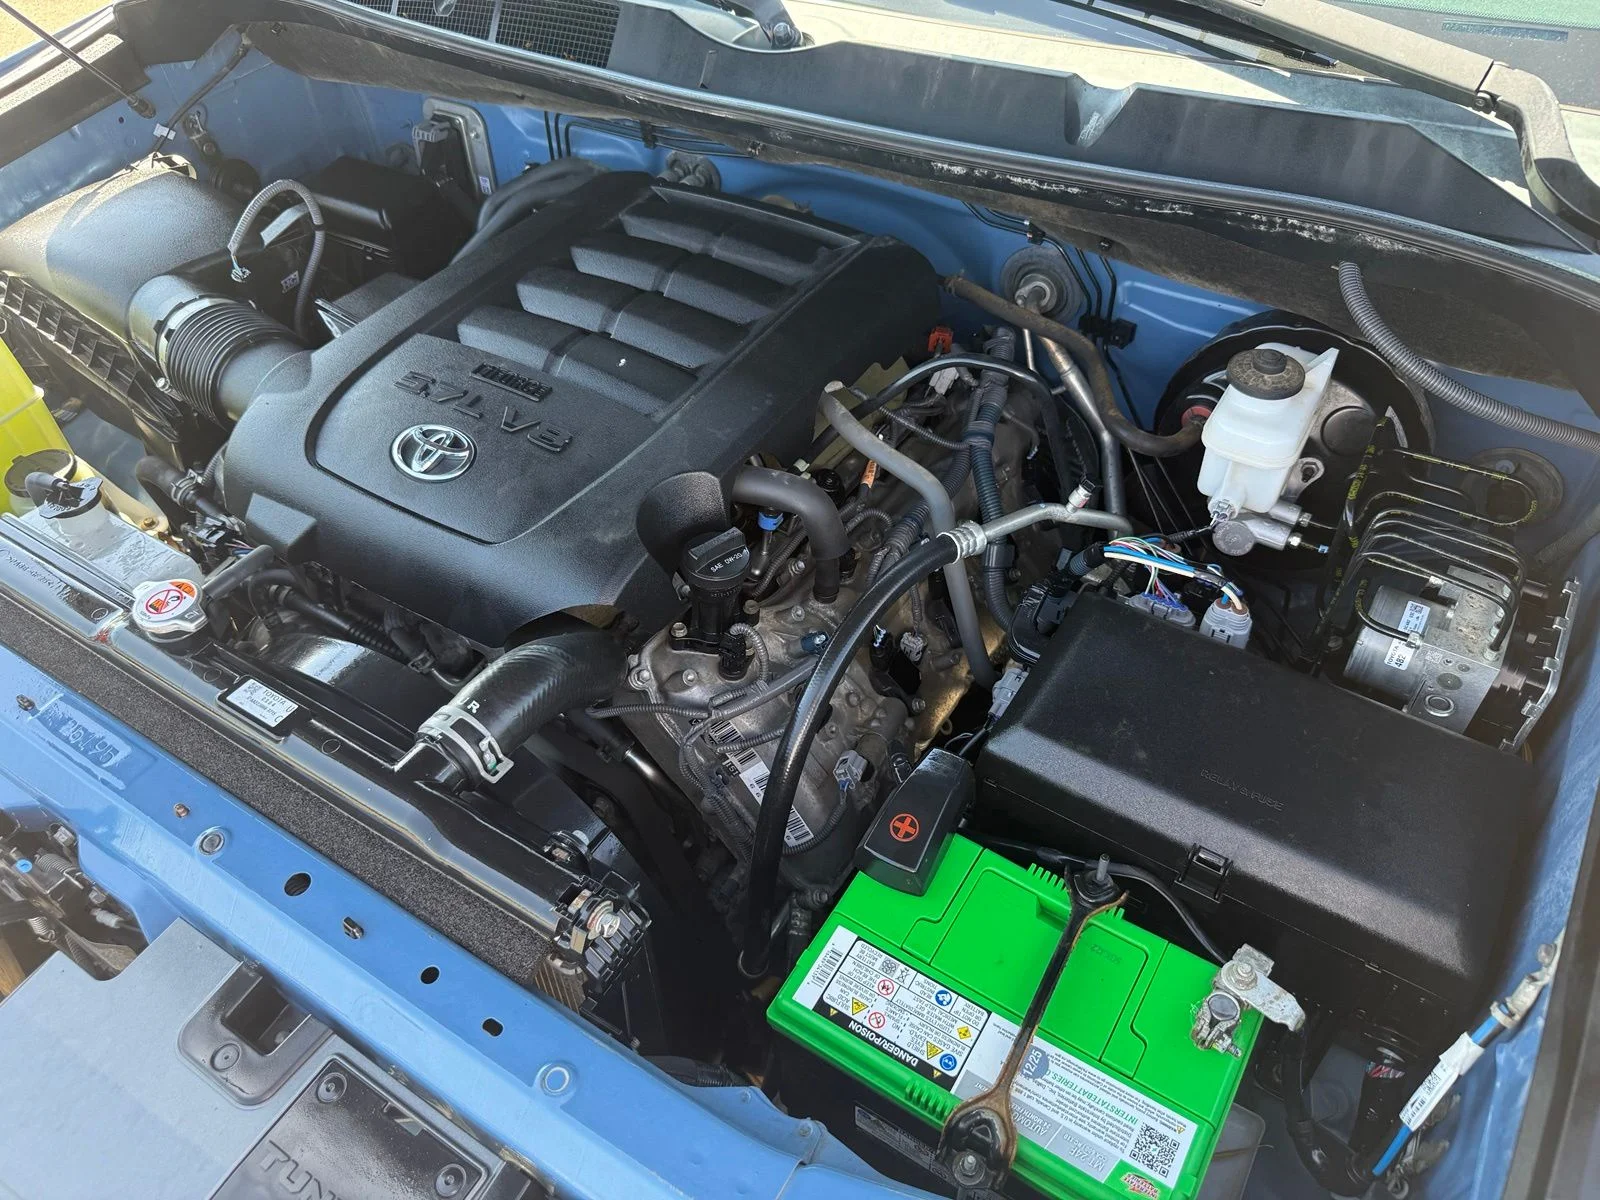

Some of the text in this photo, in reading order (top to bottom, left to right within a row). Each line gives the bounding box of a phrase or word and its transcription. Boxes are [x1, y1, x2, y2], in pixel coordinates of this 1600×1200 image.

[394, 371, 573, 452] 5.7L V8
[711, 563, 724, 573] SAE
[1395, 654, 1407, 668] 482
[263, 689, 286, 706] TOYOTA
[467, 700, 480, 714] R
[856, 953, 875, 966] BATTERY
[863, 950, 878, 961] MUST
[852, 967, 868, 978] REACH
[853, 973, 863, 981] OUT
[834, 978, 872, 1003] CAUSE BLINDNESS
[852, 982, 869, 996] SEVERE
[862, 979, 874, 988] KEEP
[837, 993, 849, 1003] ACID
[839, 987, 850, 996] CAN
[918, 989, 932, 999] READ
[825, 993, 850, 1010] SULFURIC
[915, 1003, 925, 1011] GET
[925, 1002, 937, 1012] HELP
[895, 998, 952, 1033] FLUSH EYES IMMEDIATELY
[937, 1009, 958, 1023] MEDICAL
[953, 1008, 961, 1016] TIP
[961, 1006, 975, 1017] OPEN
[961, 1013, 971, 1022] NOT
[891, 1022, 900, 1030] NO
[942, 1018, 955, 1028] WITH
[847, 1020, 919, 1066] DANGER/POISON
[908, 1021, 963, 1056] SIVE GASES CAN CAUSE
[940, 1033, 966, 1050] BLINDNESS
[905, 1041, 925, 1055] SHIELD
[1022, 1049, 1043, 1075] 12/25
[1043, 1068, 1138, 1124] INTERSTATEBATTERIES.C
[1011, 1111, 1047, 1135] AUTOMO
[260, 1139, 337, 1200] TUN
